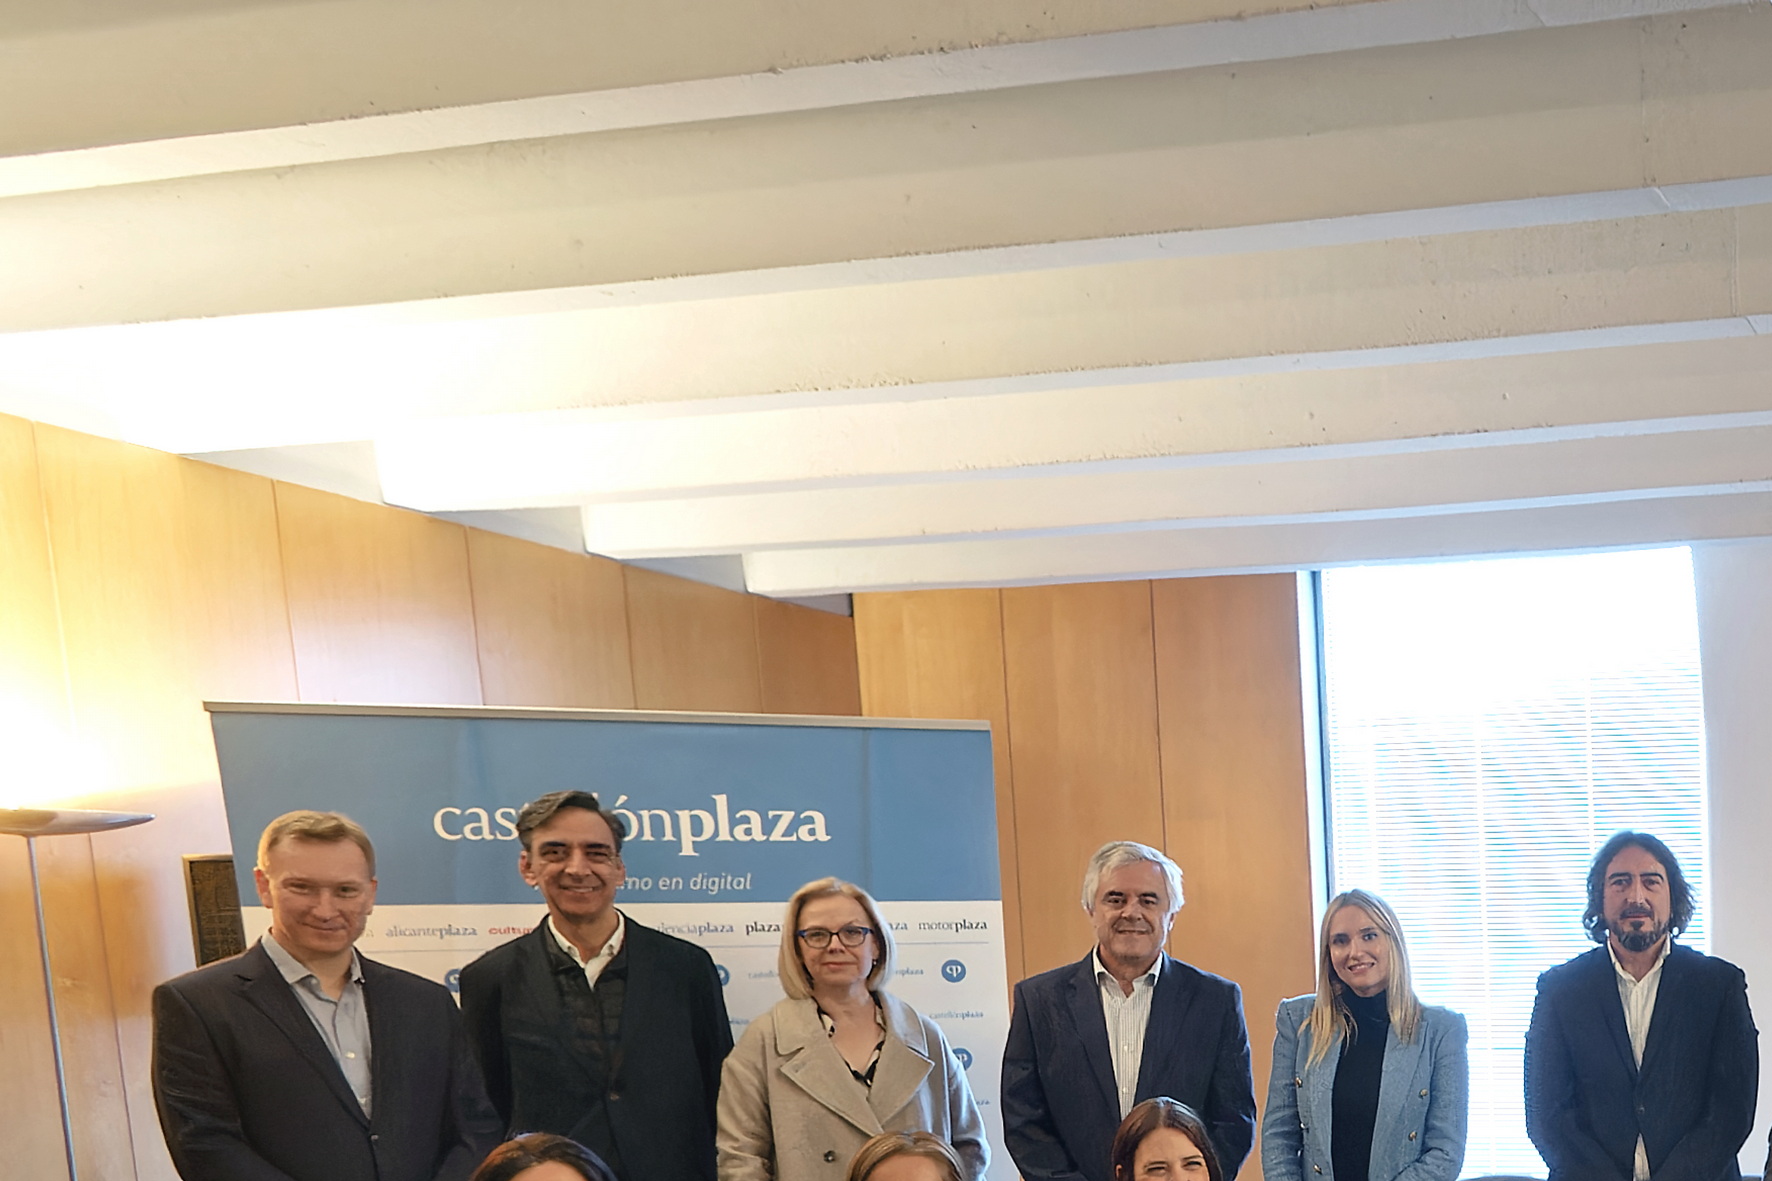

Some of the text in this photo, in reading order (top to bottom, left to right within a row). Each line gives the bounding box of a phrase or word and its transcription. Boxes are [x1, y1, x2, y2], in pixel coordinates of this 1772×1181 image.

[433, 794, 831, 857] casónplaza
[659, 877, 683, 892] en
[690, 873, 752, 895] digital
[918, 919, 988, 933] motorplaza
